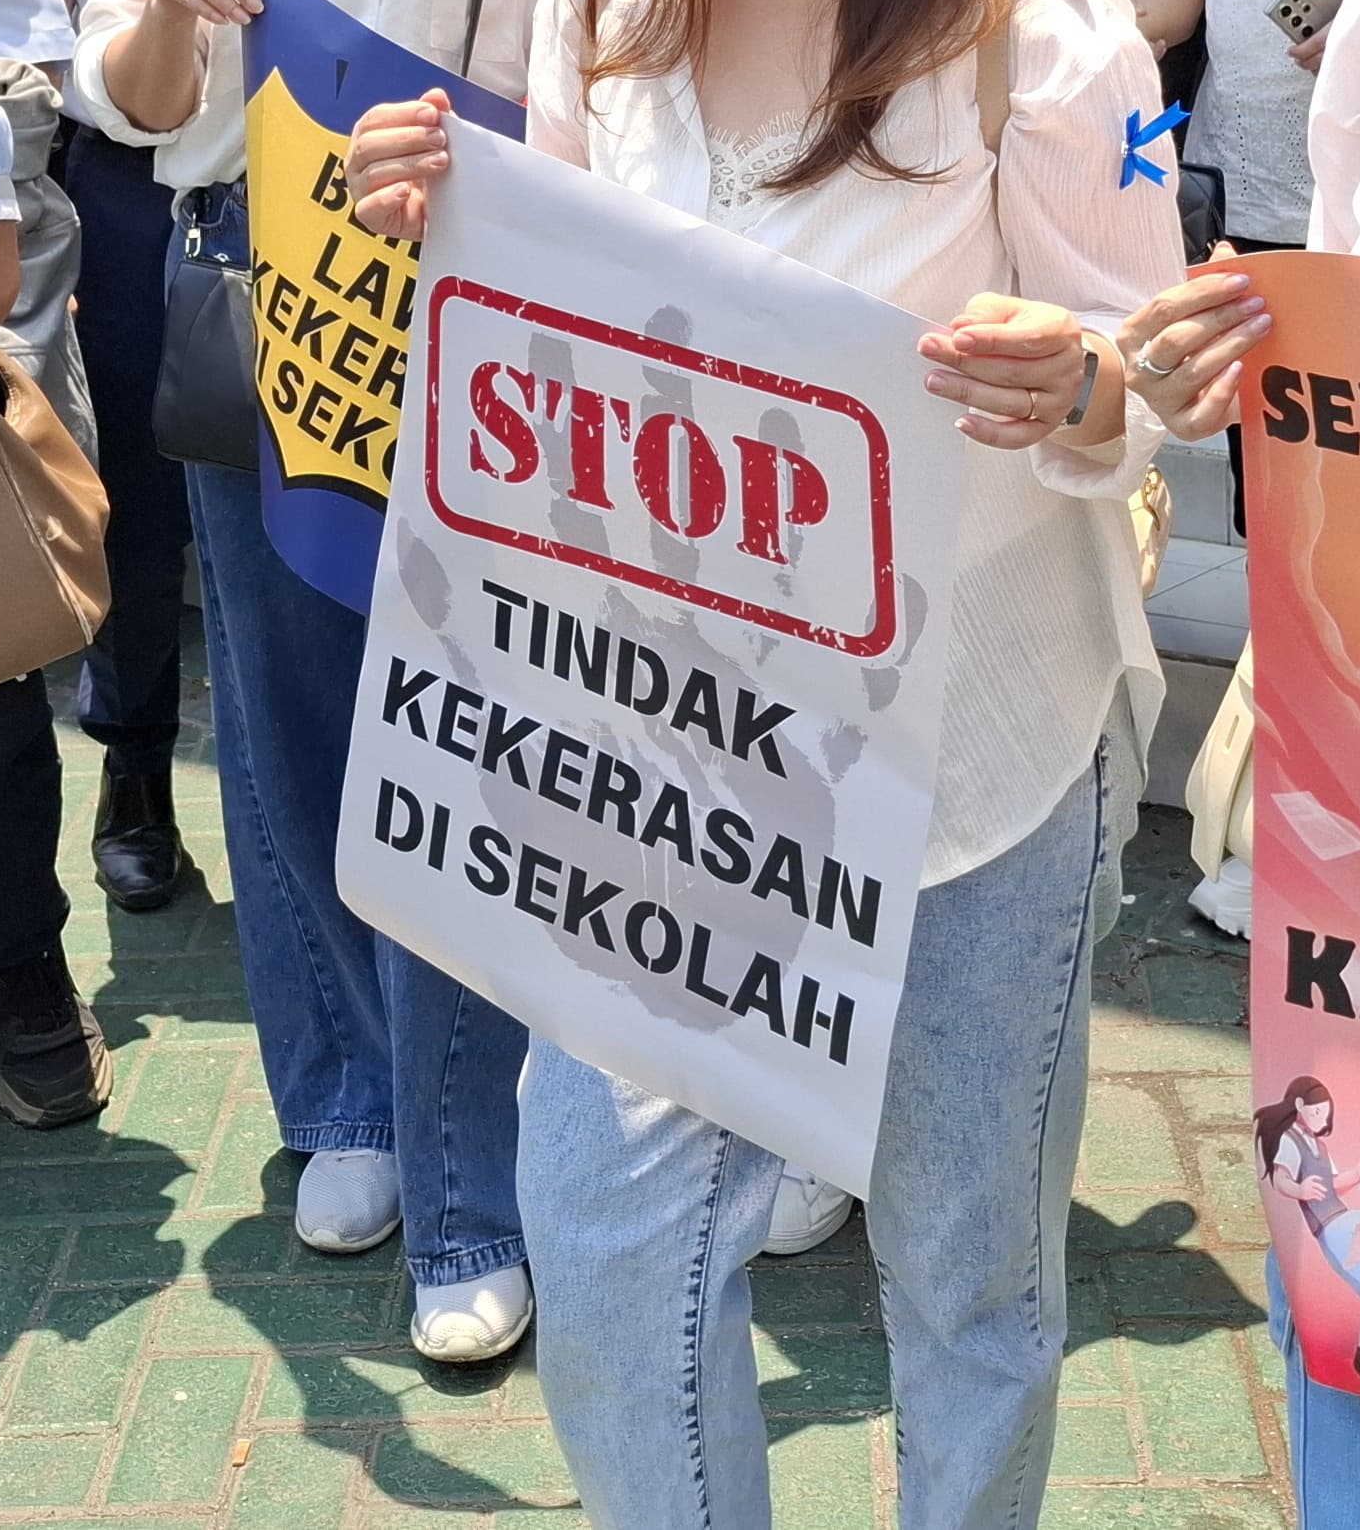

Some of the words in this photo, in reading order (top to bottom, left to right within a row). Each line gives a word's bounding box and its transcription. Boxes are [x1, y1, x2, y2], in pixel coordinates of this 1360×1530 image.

[468, 359, 829, 566] STOP
[381, 655, 883, 950] KEKERASAN
[481, 578, 796, 780] TINDAK
[374, 776, 451, 873] DI
[464, 823, 855, 1068] SEKOLAH
